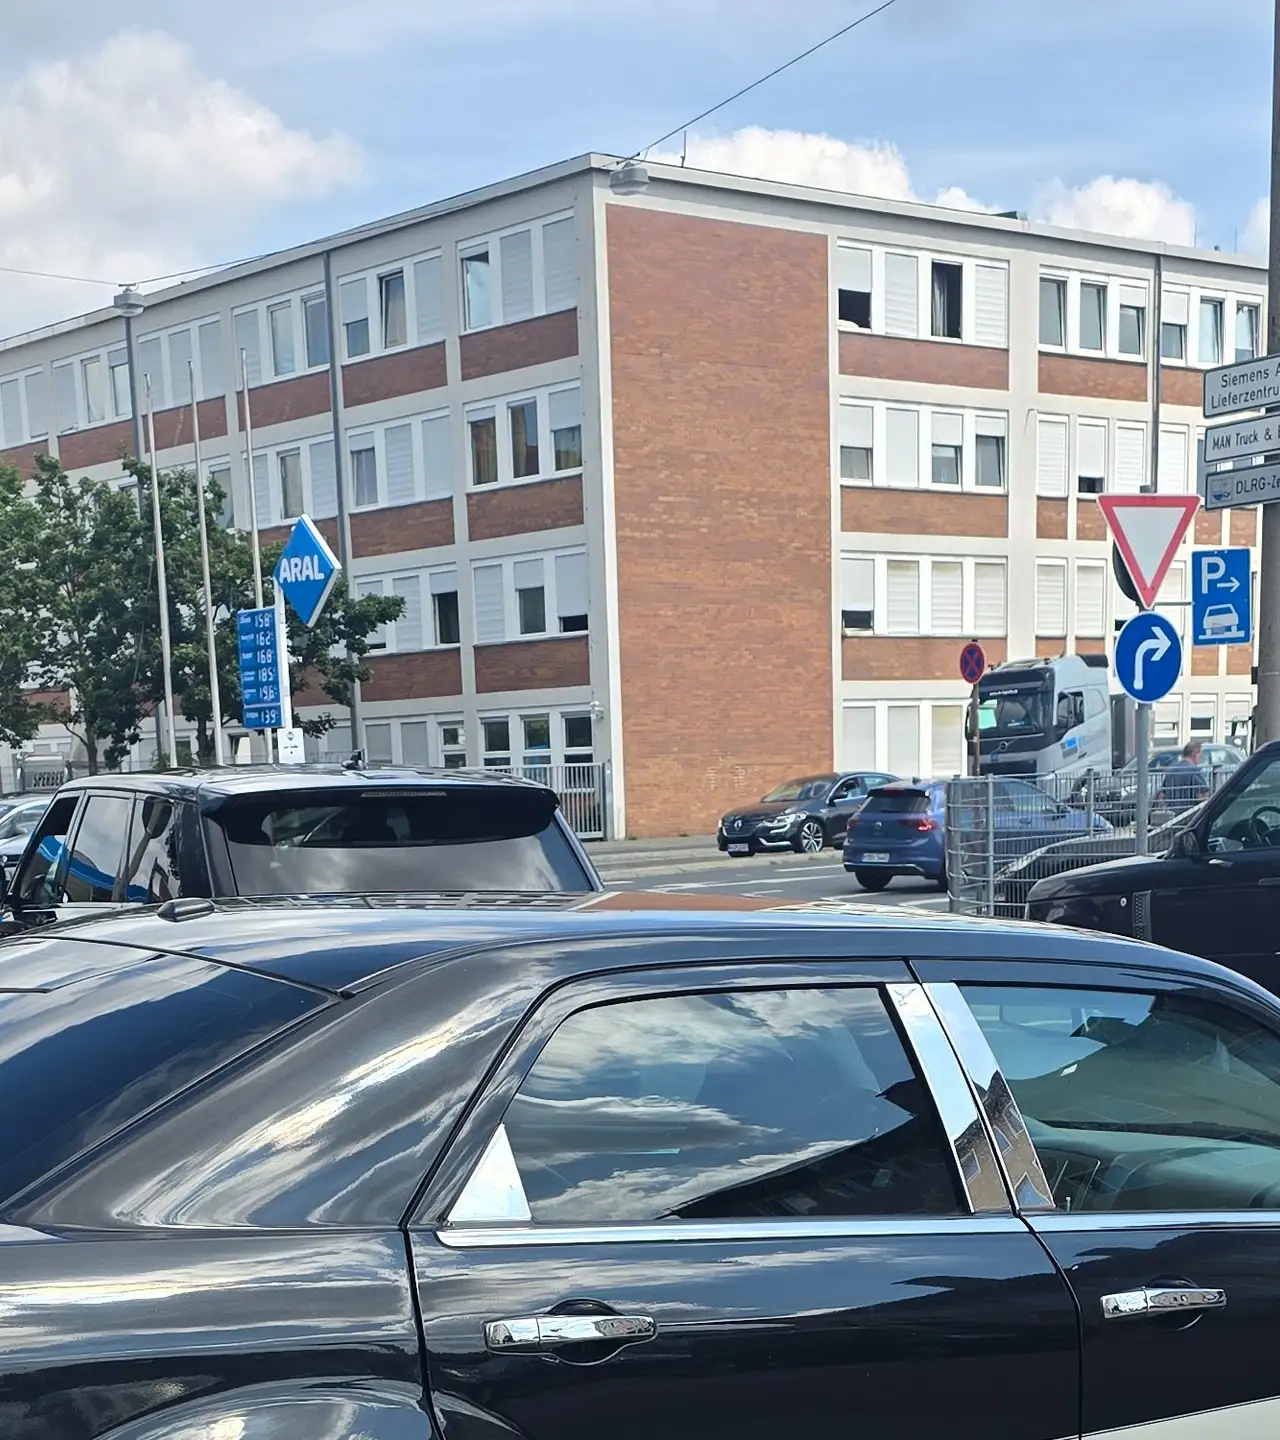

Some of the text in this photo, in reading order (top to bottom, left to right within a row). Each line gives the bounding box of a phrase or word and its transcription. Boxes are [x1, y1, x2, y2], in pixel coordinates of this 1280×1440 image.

[1221, 369, 1270, 389] Siemens
[1212, 434, 1232, 450] MAN
[1235, 430, 1259, 447] Truck
[1264, 428, 1272, 440] &
[280, 555, 324, 583] ARAL
[1201, 556, 1226, 594] P
